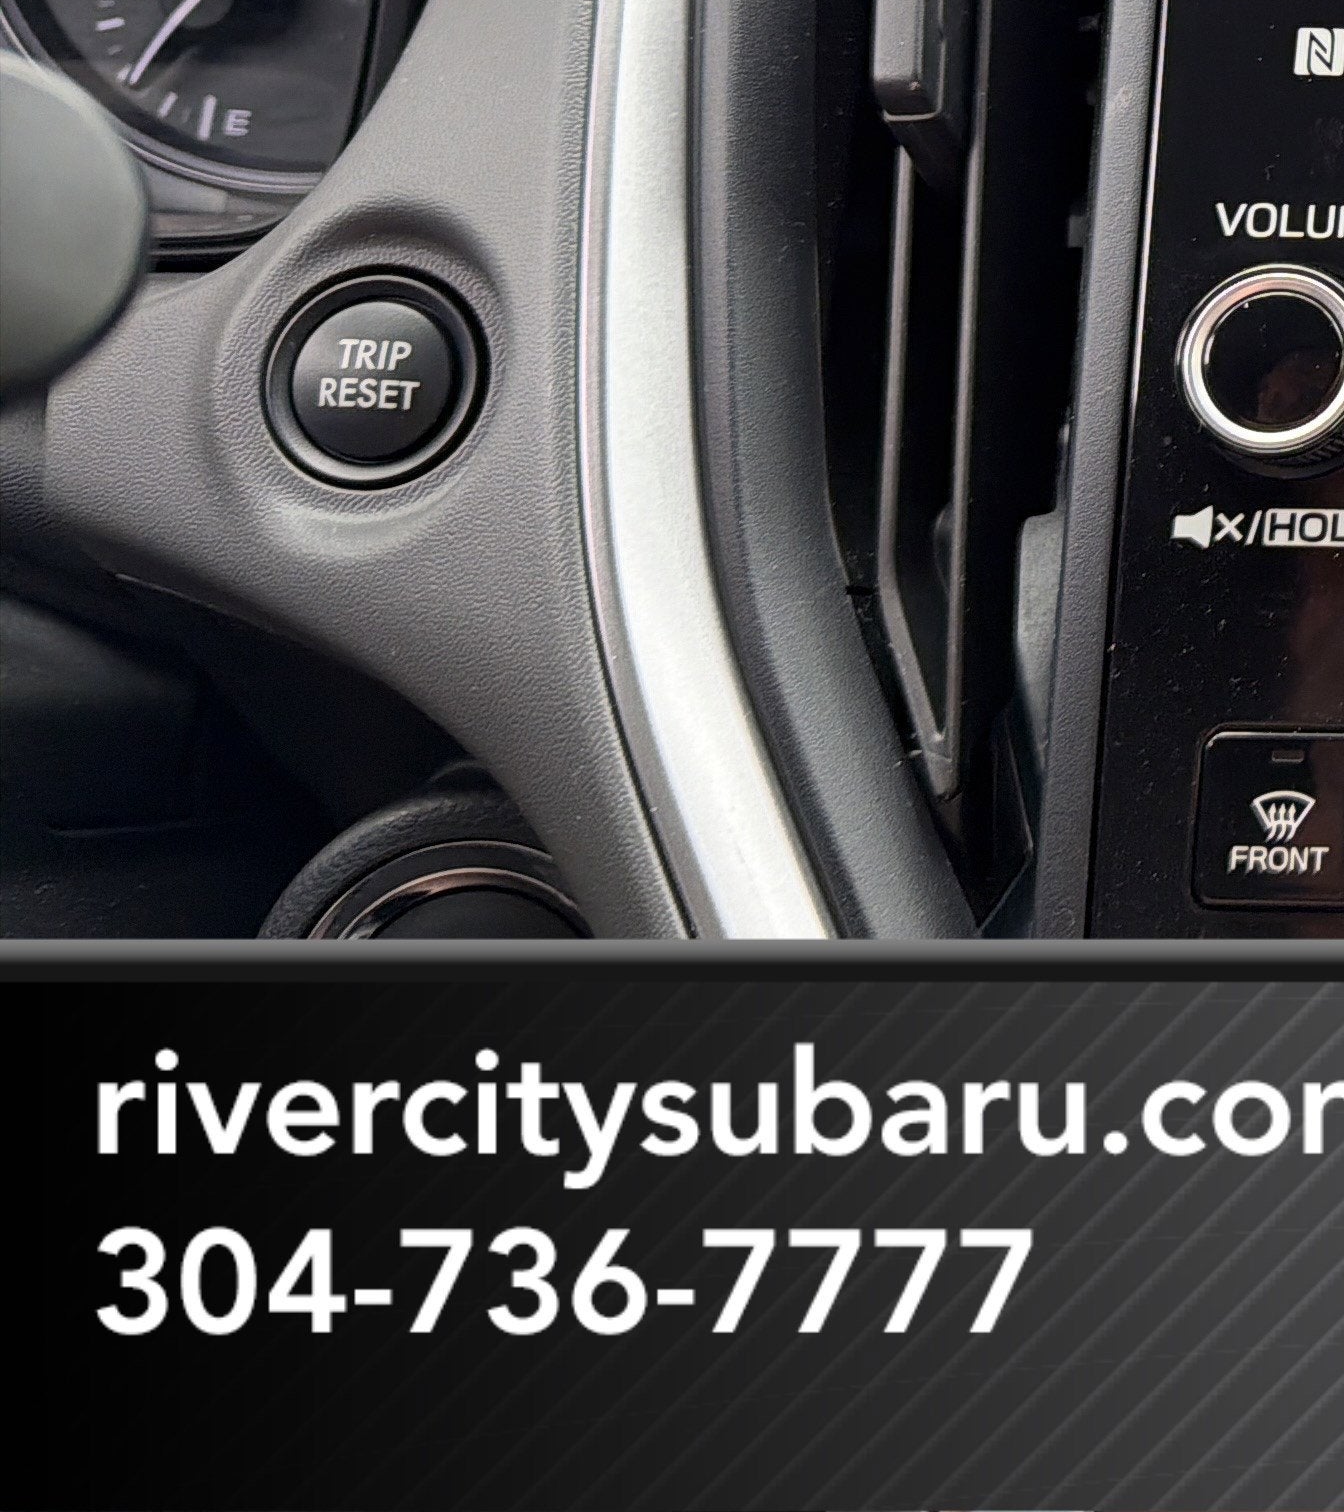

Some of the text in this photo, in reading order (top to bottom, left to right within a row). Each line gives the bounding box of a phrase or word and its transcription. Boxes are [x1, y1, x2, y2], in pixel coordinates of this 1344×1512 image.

[223, 109, 251, 137] E
[338, 338, 413, 371] TRIP
[317, 377, 421, 411] RESET
[1228, 846, 1330, 874] FRONT
